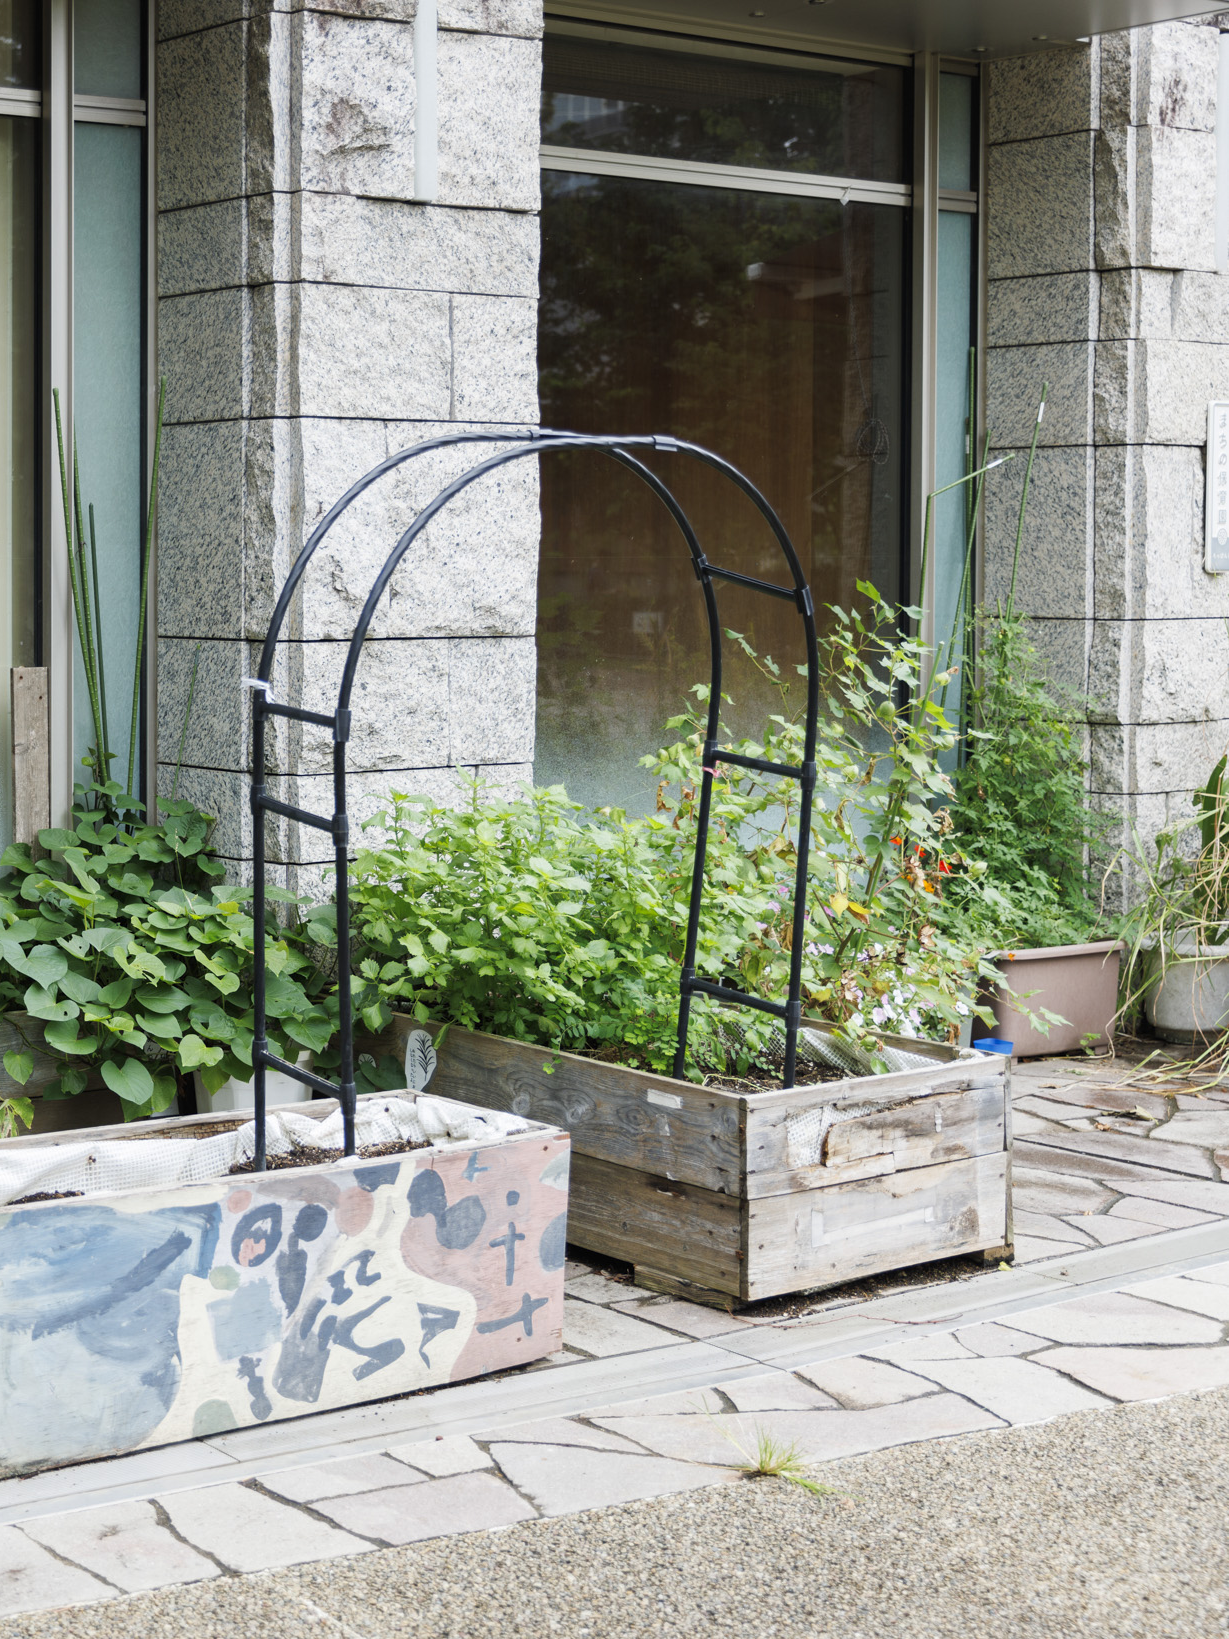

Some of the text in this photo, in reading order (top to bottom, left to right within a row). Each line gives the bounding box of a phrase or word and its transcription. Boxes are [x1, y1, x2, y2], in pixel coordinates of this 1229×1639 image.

[1217, 413, 1228, 524] まちの保育園
